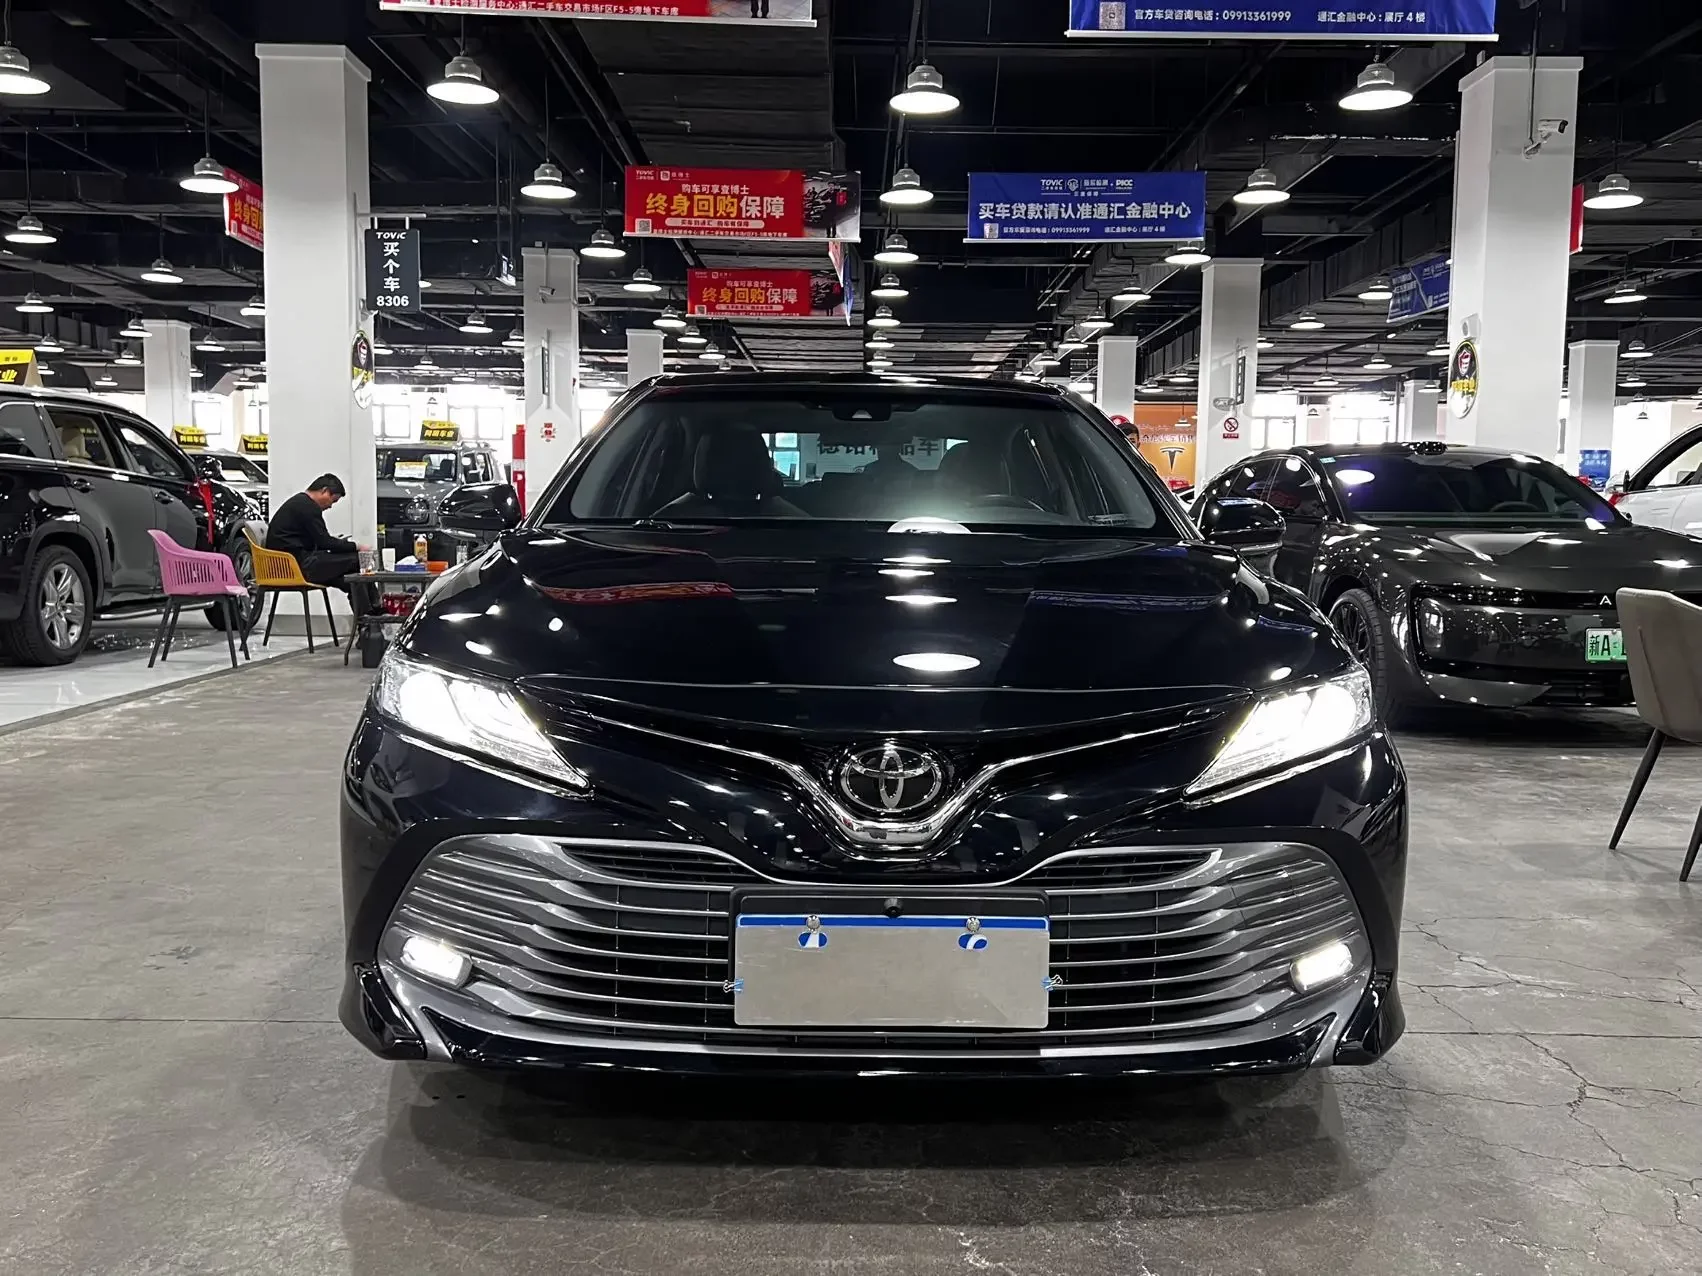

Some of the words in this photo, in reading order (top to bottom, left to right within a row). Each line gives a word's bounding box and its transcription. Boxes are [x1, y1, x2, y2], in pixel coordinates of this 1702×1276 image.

[681, 183, 750, 195] 购车可享查博士
[646, 192, 785, 219] 终身回购保障
[978, 202, 1192, 220] 买车贷款请认准通汇金融中心
[376, 231, 407, 240] TOVIC
[383, 242, 401, 292] 买个车
[376, 295, 409, 307] 8306
[702, 287, 798, 305] 终身回购保障
